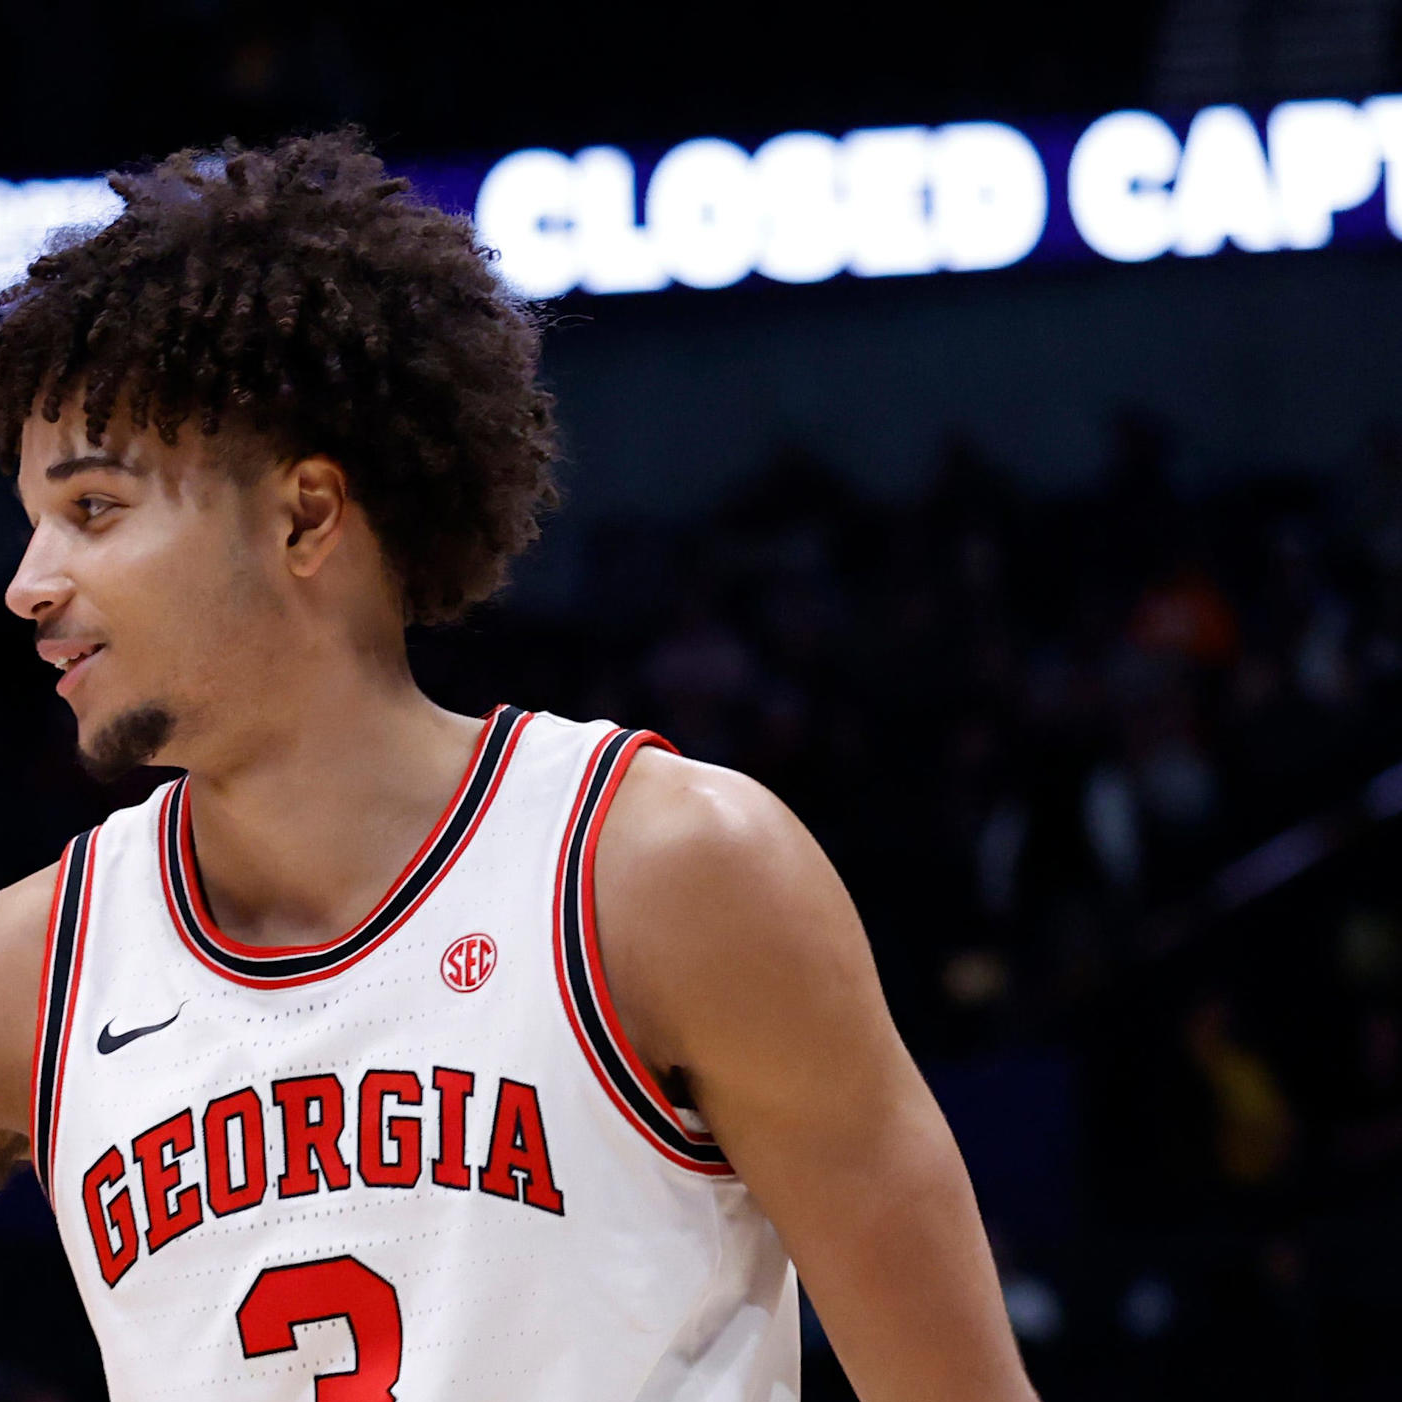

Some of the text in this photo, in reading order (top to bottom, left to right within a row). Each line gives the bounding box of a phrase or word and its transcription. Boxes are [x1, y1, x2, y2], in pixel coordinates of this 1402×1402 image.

[474, 122, 1048, 300] CLOSED
[446, 938, 493, 987] SEC
[82, 1065, 565, 1290] GEORGIA
